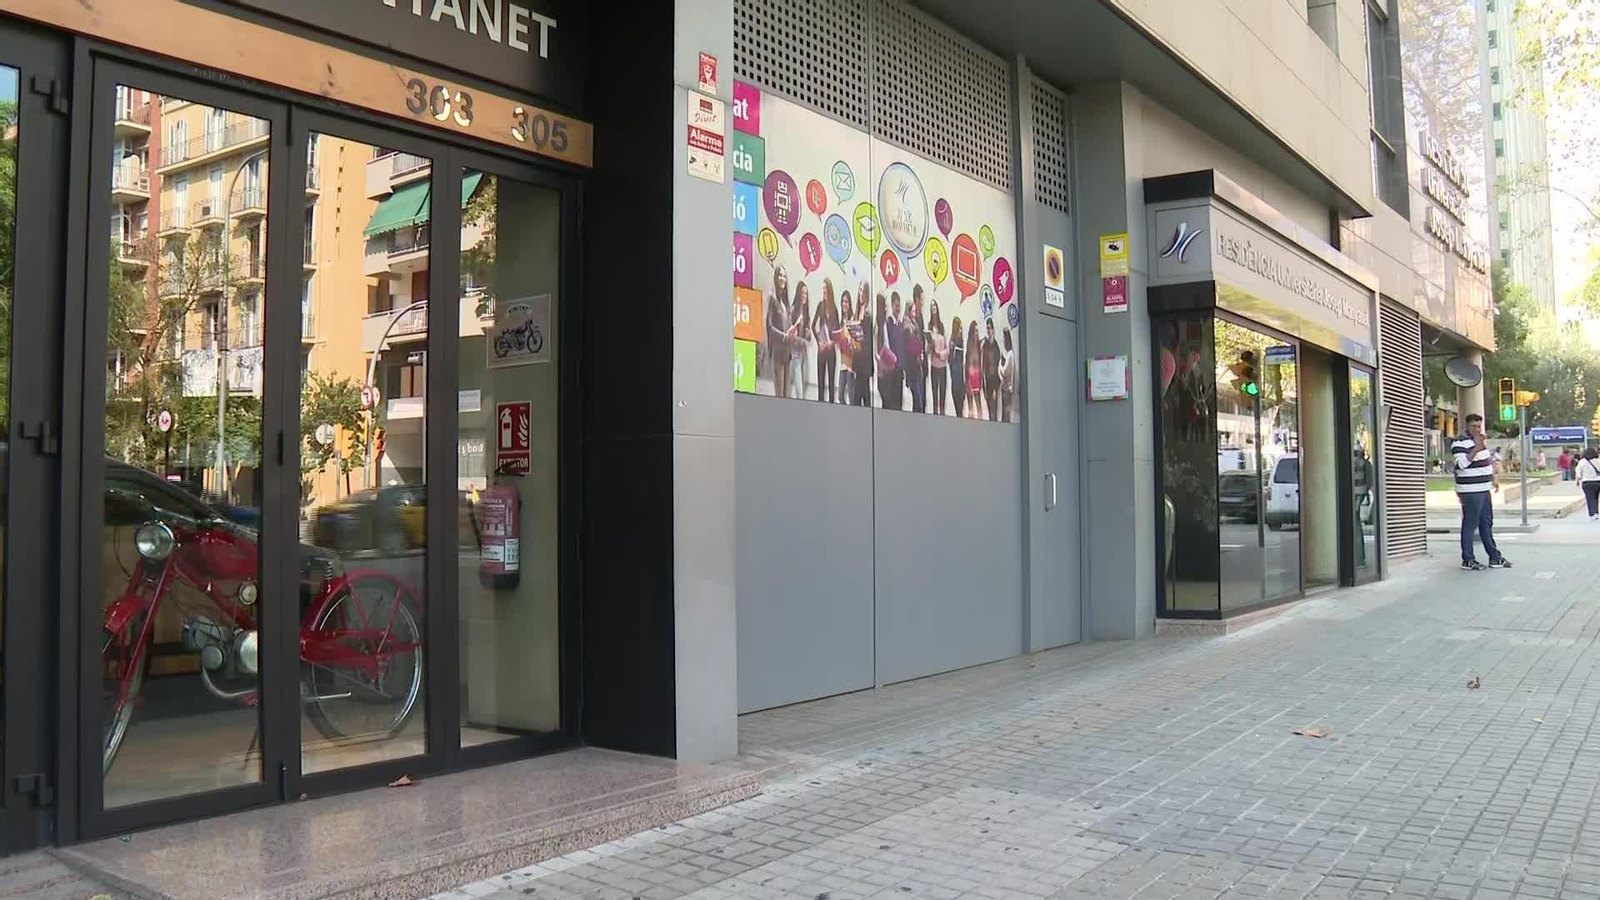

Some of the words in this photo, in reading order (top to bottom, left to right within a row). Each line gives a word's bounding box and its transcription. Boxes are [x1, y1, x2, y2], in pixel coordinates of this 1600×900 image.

[383, 0, 557, 59] ANET
[405, 78, 473, 127] 303
[511, 105, 568, 151] 305
[690, 128, 723, 148] Alarma
